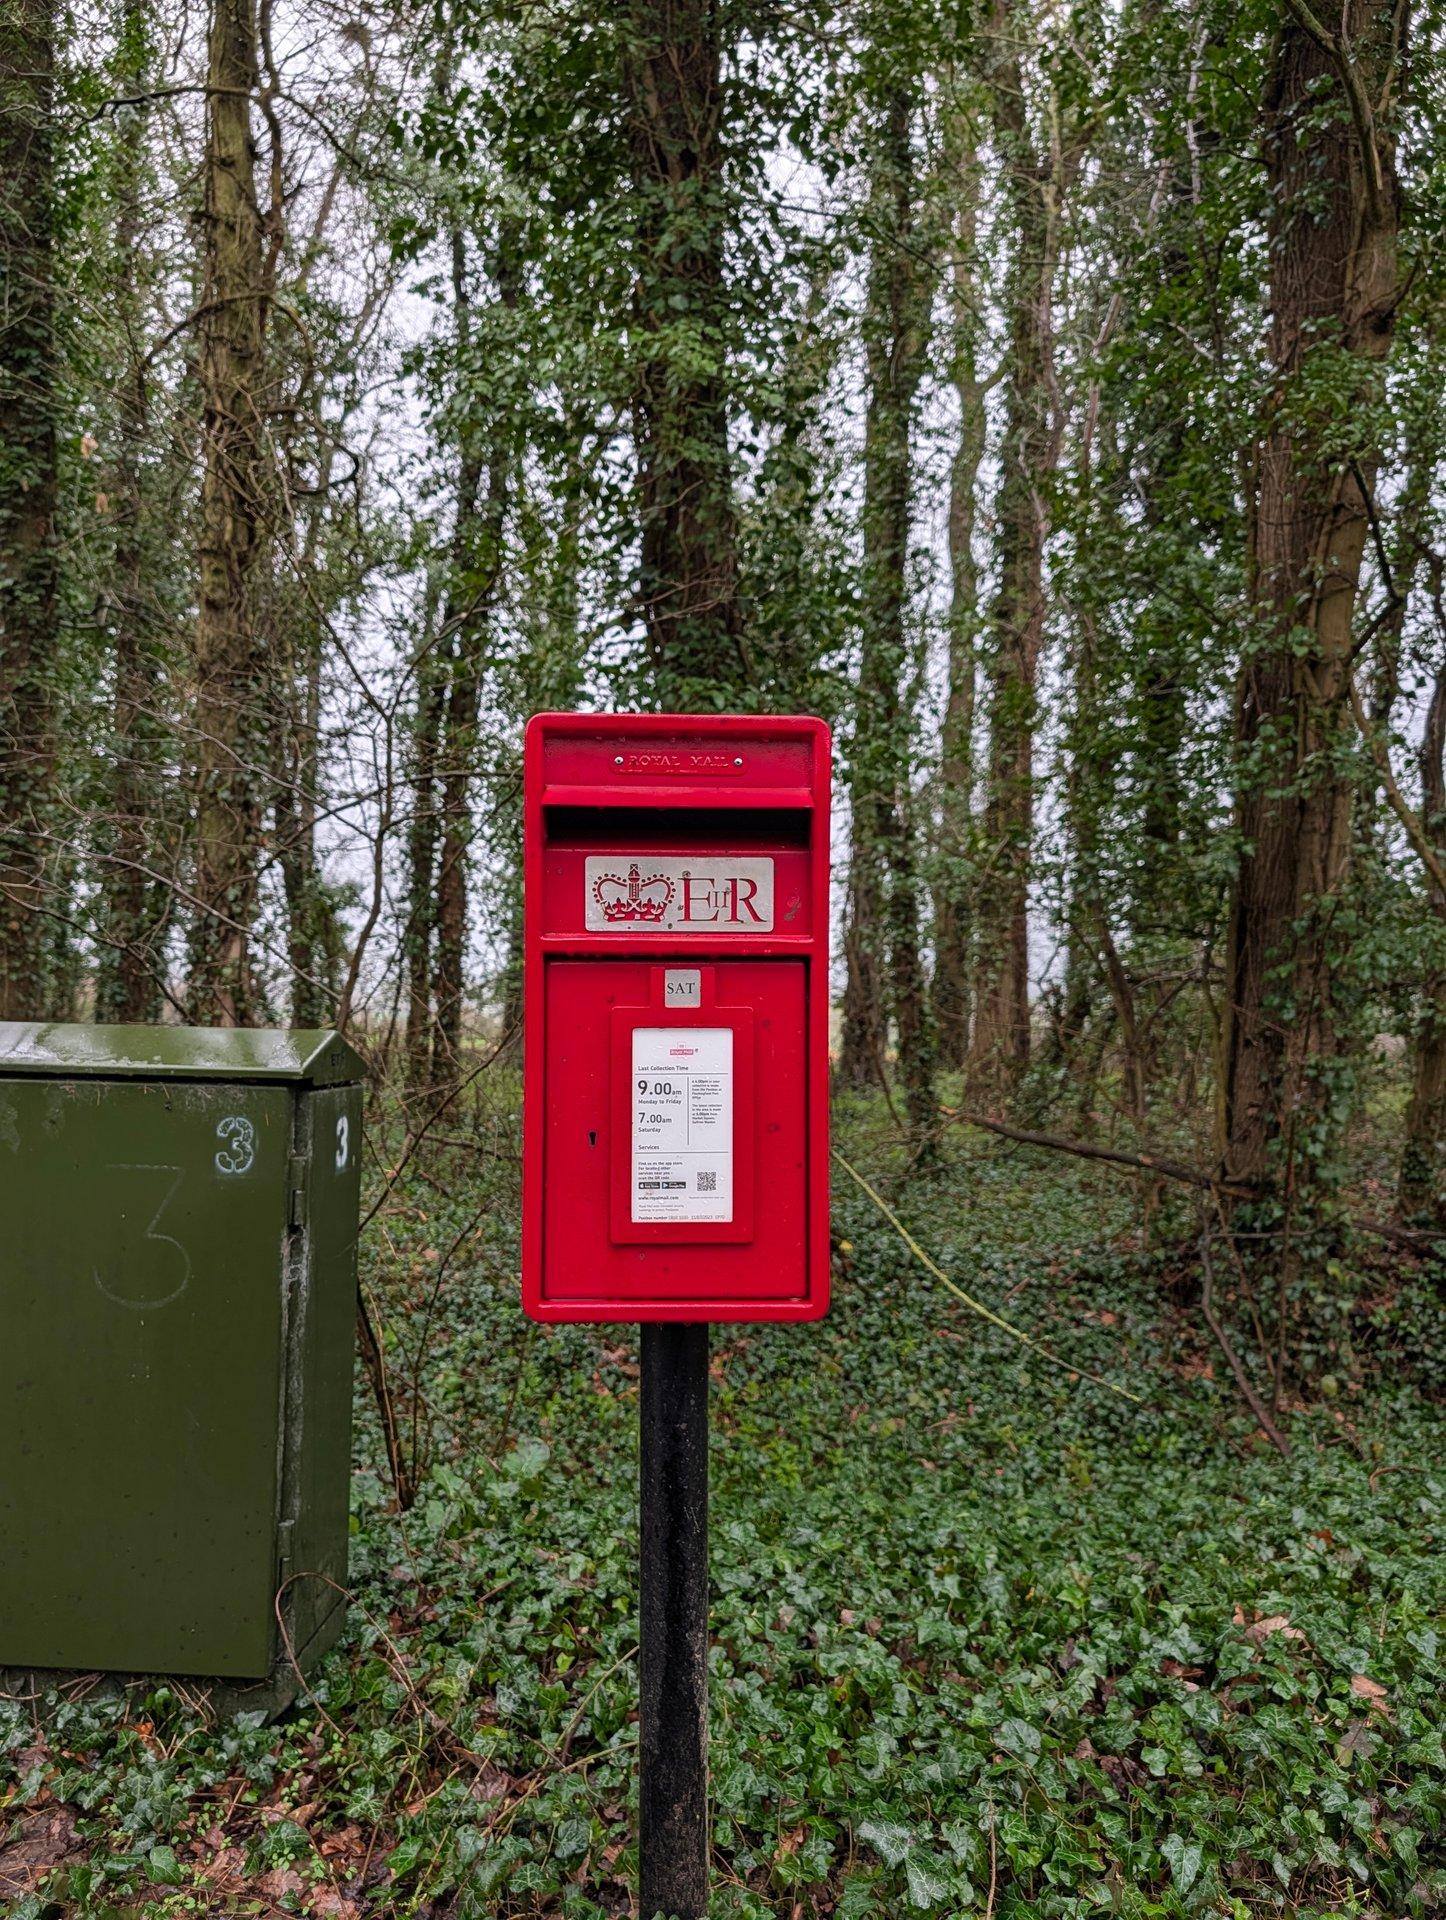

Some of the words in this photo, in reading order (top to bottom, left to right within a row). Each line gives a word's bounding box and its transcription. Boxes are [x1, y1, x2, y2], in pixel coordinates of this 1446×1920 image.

[629, 755, 680, 765] ROYAL
[690, 755, 729, 766] MAIL
[666, 982, 696, 995] SAT
[216, 1116, 254, 1174] 3
[335, 1115, 349, 1168] 3
[92, 1163, 191, 1309] 3
